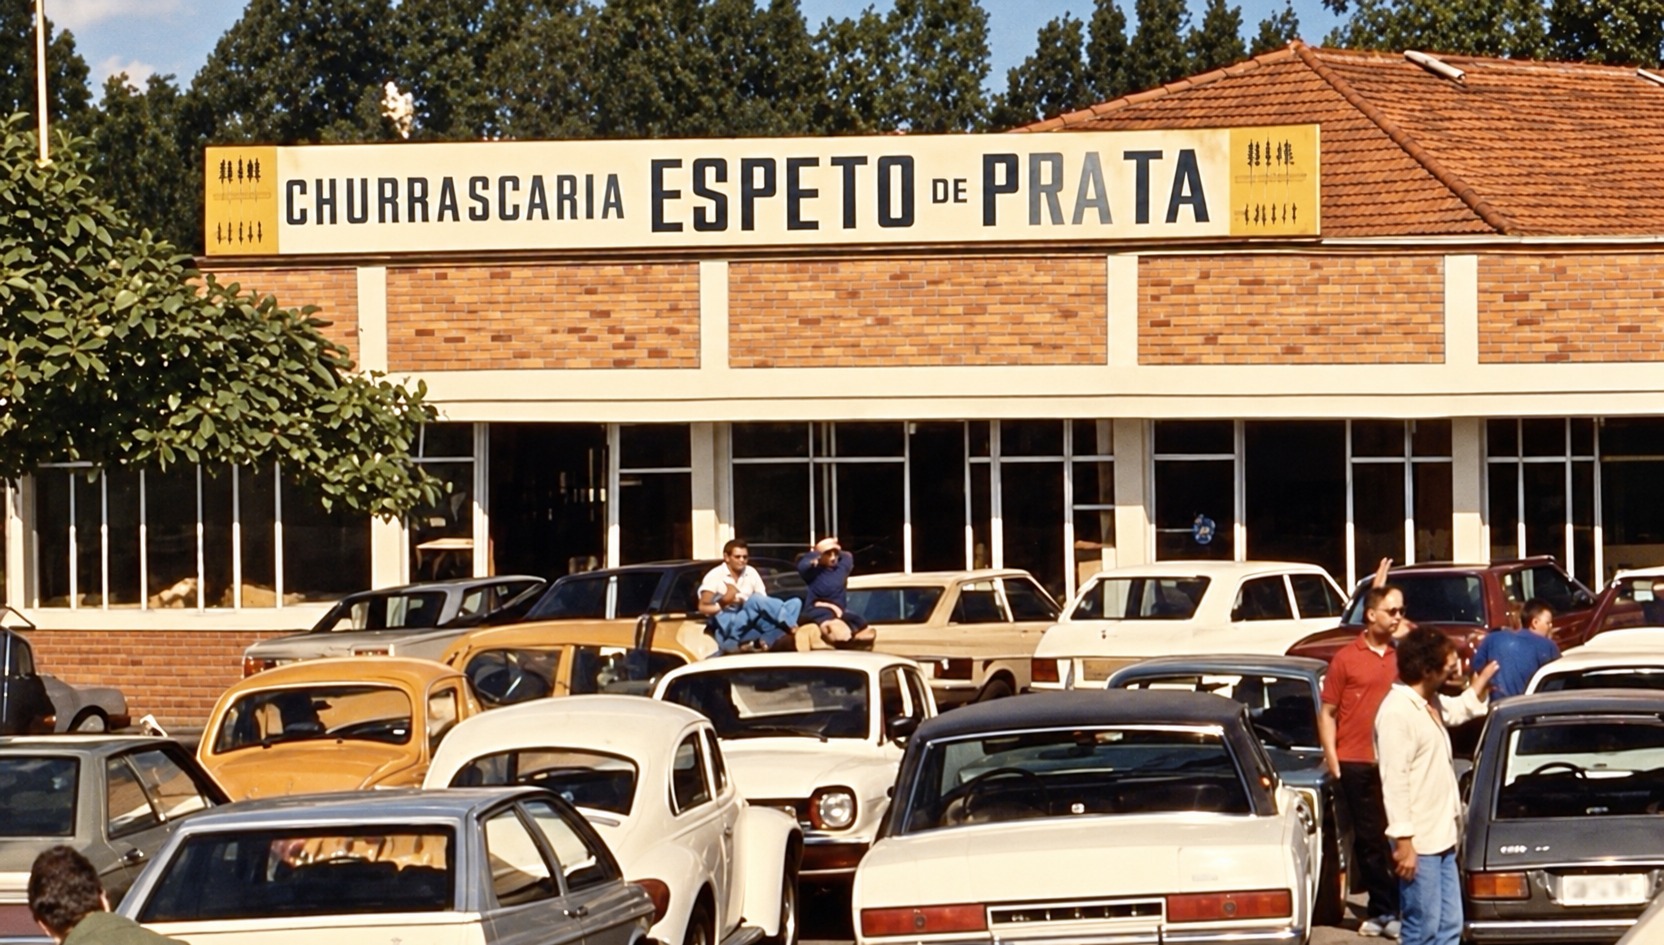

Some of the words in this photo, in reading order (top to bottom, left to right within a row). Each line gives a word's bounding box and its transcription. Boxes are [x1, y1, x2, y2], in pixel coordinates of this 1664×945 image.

[285, 173, 625, 226] CHURRASCARIA
[650, 154, 915, 234] ESPETO
[931, 178, 968, 204] DE
[982, 148, 1211, 227] PRATA
